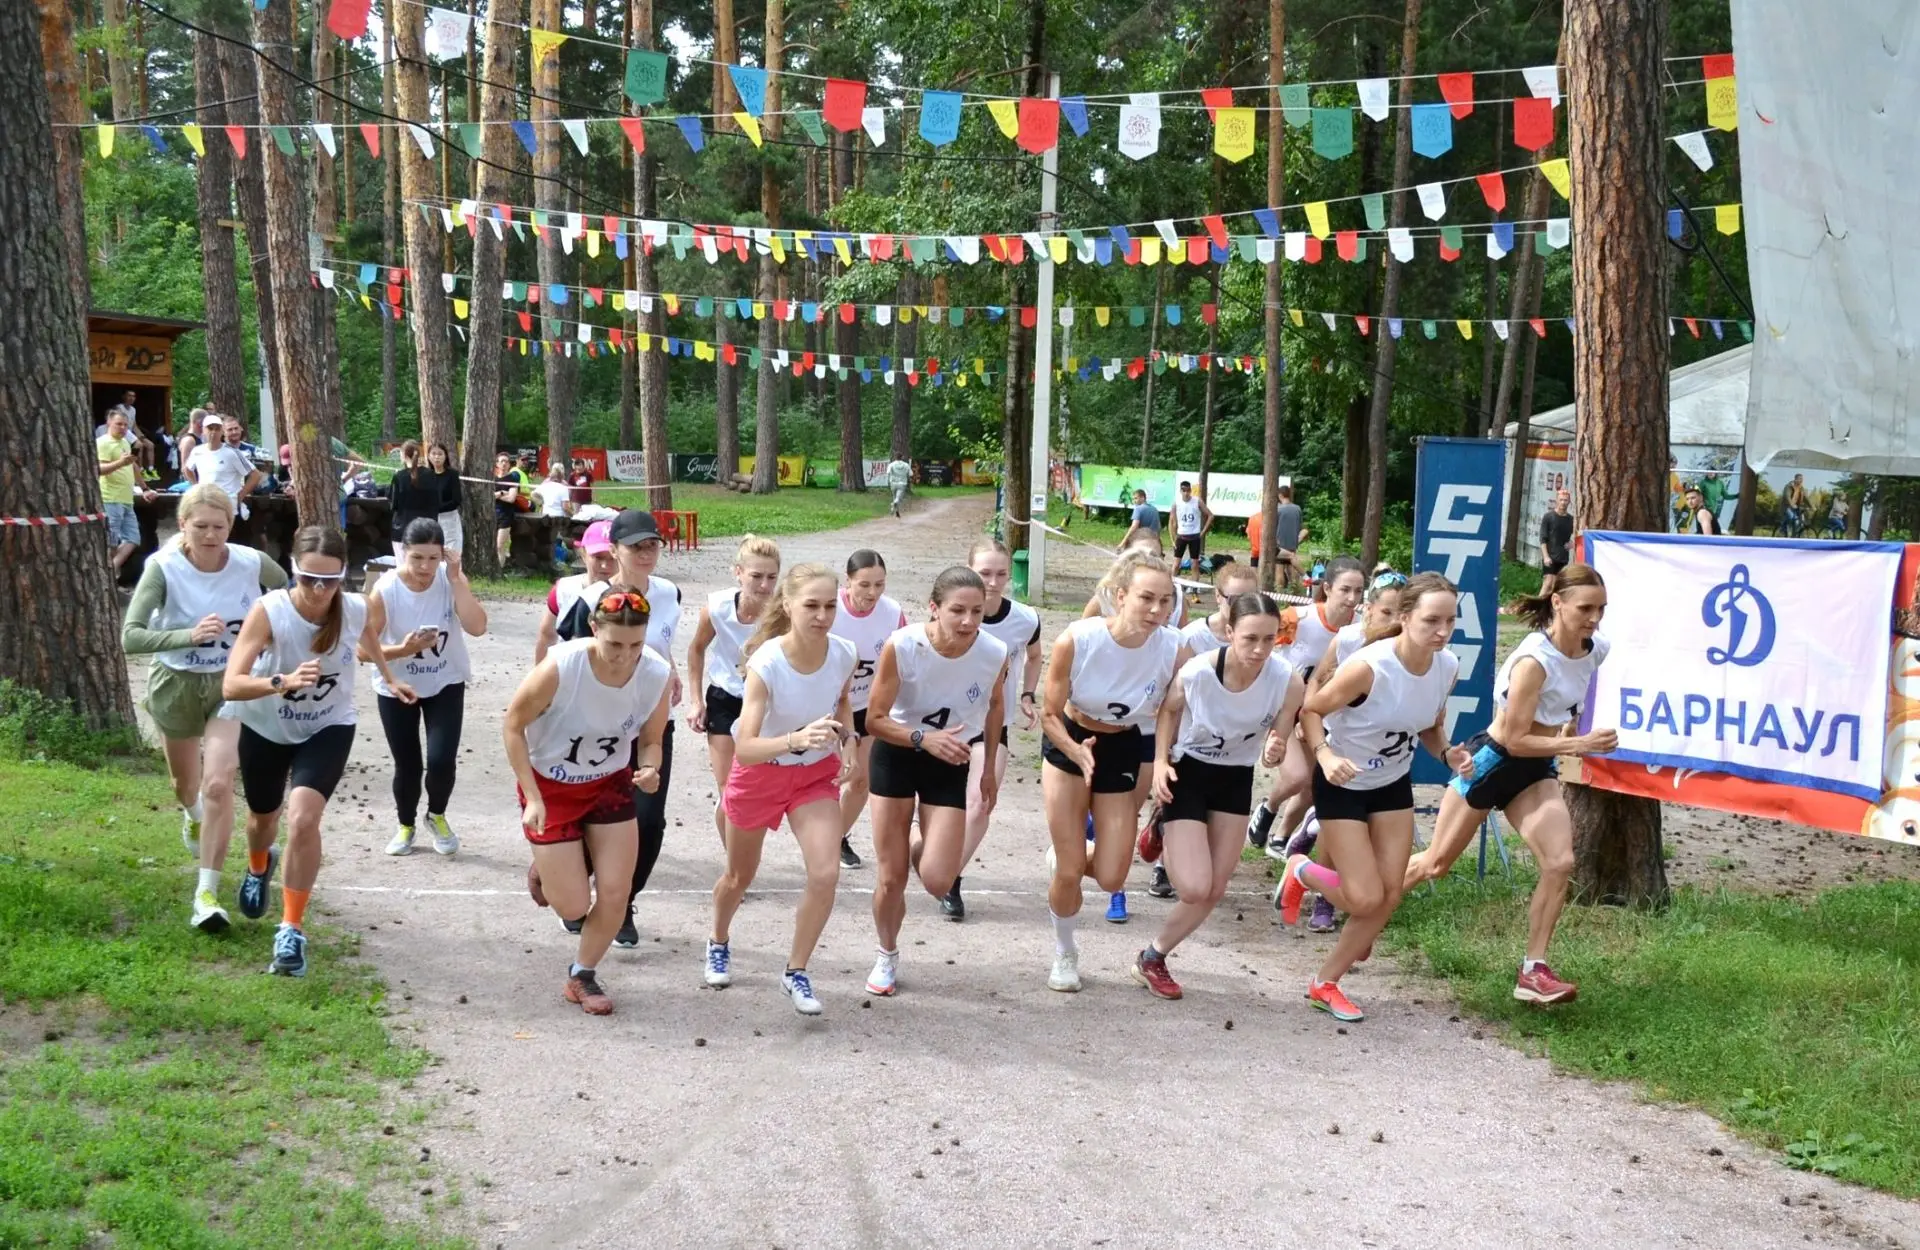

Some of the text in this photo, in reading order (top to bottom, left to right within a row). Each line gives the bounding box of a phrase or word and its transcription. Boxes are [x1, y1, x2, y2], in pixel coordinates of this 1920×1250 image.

[615, 455, 644, 467] КРАЯН
[1181, 513, 1195, 523] 49
[921, 707, 951, 730] 4
[1619, 687, 1861, 762] БАРНАУЛ
[563, 735, 620, 767] 13
